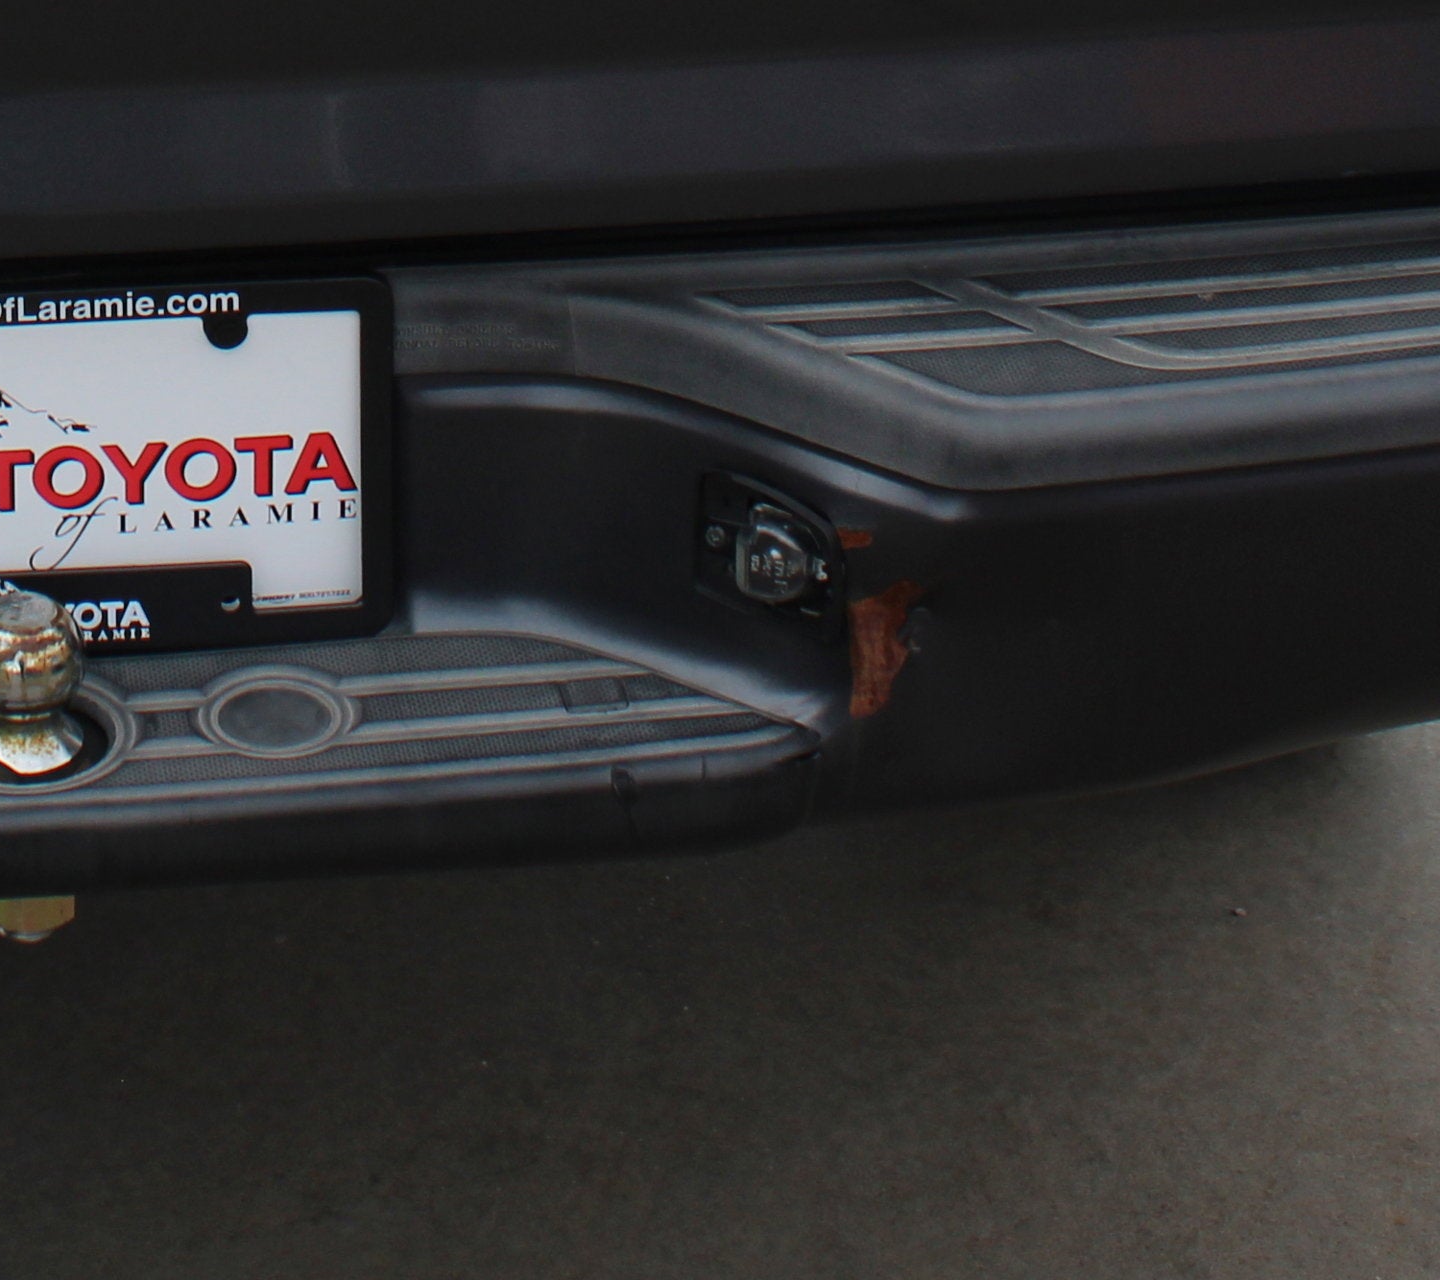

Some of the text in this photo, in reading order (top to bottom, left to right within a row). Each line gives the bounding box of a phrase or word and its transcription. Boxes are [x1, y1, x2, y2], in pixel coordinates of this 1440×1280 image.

[118, 497, 359, 535] LARAMIE
[65, 600, 151, 628] OTA
[82, 628, 151, 642] RAMIE
